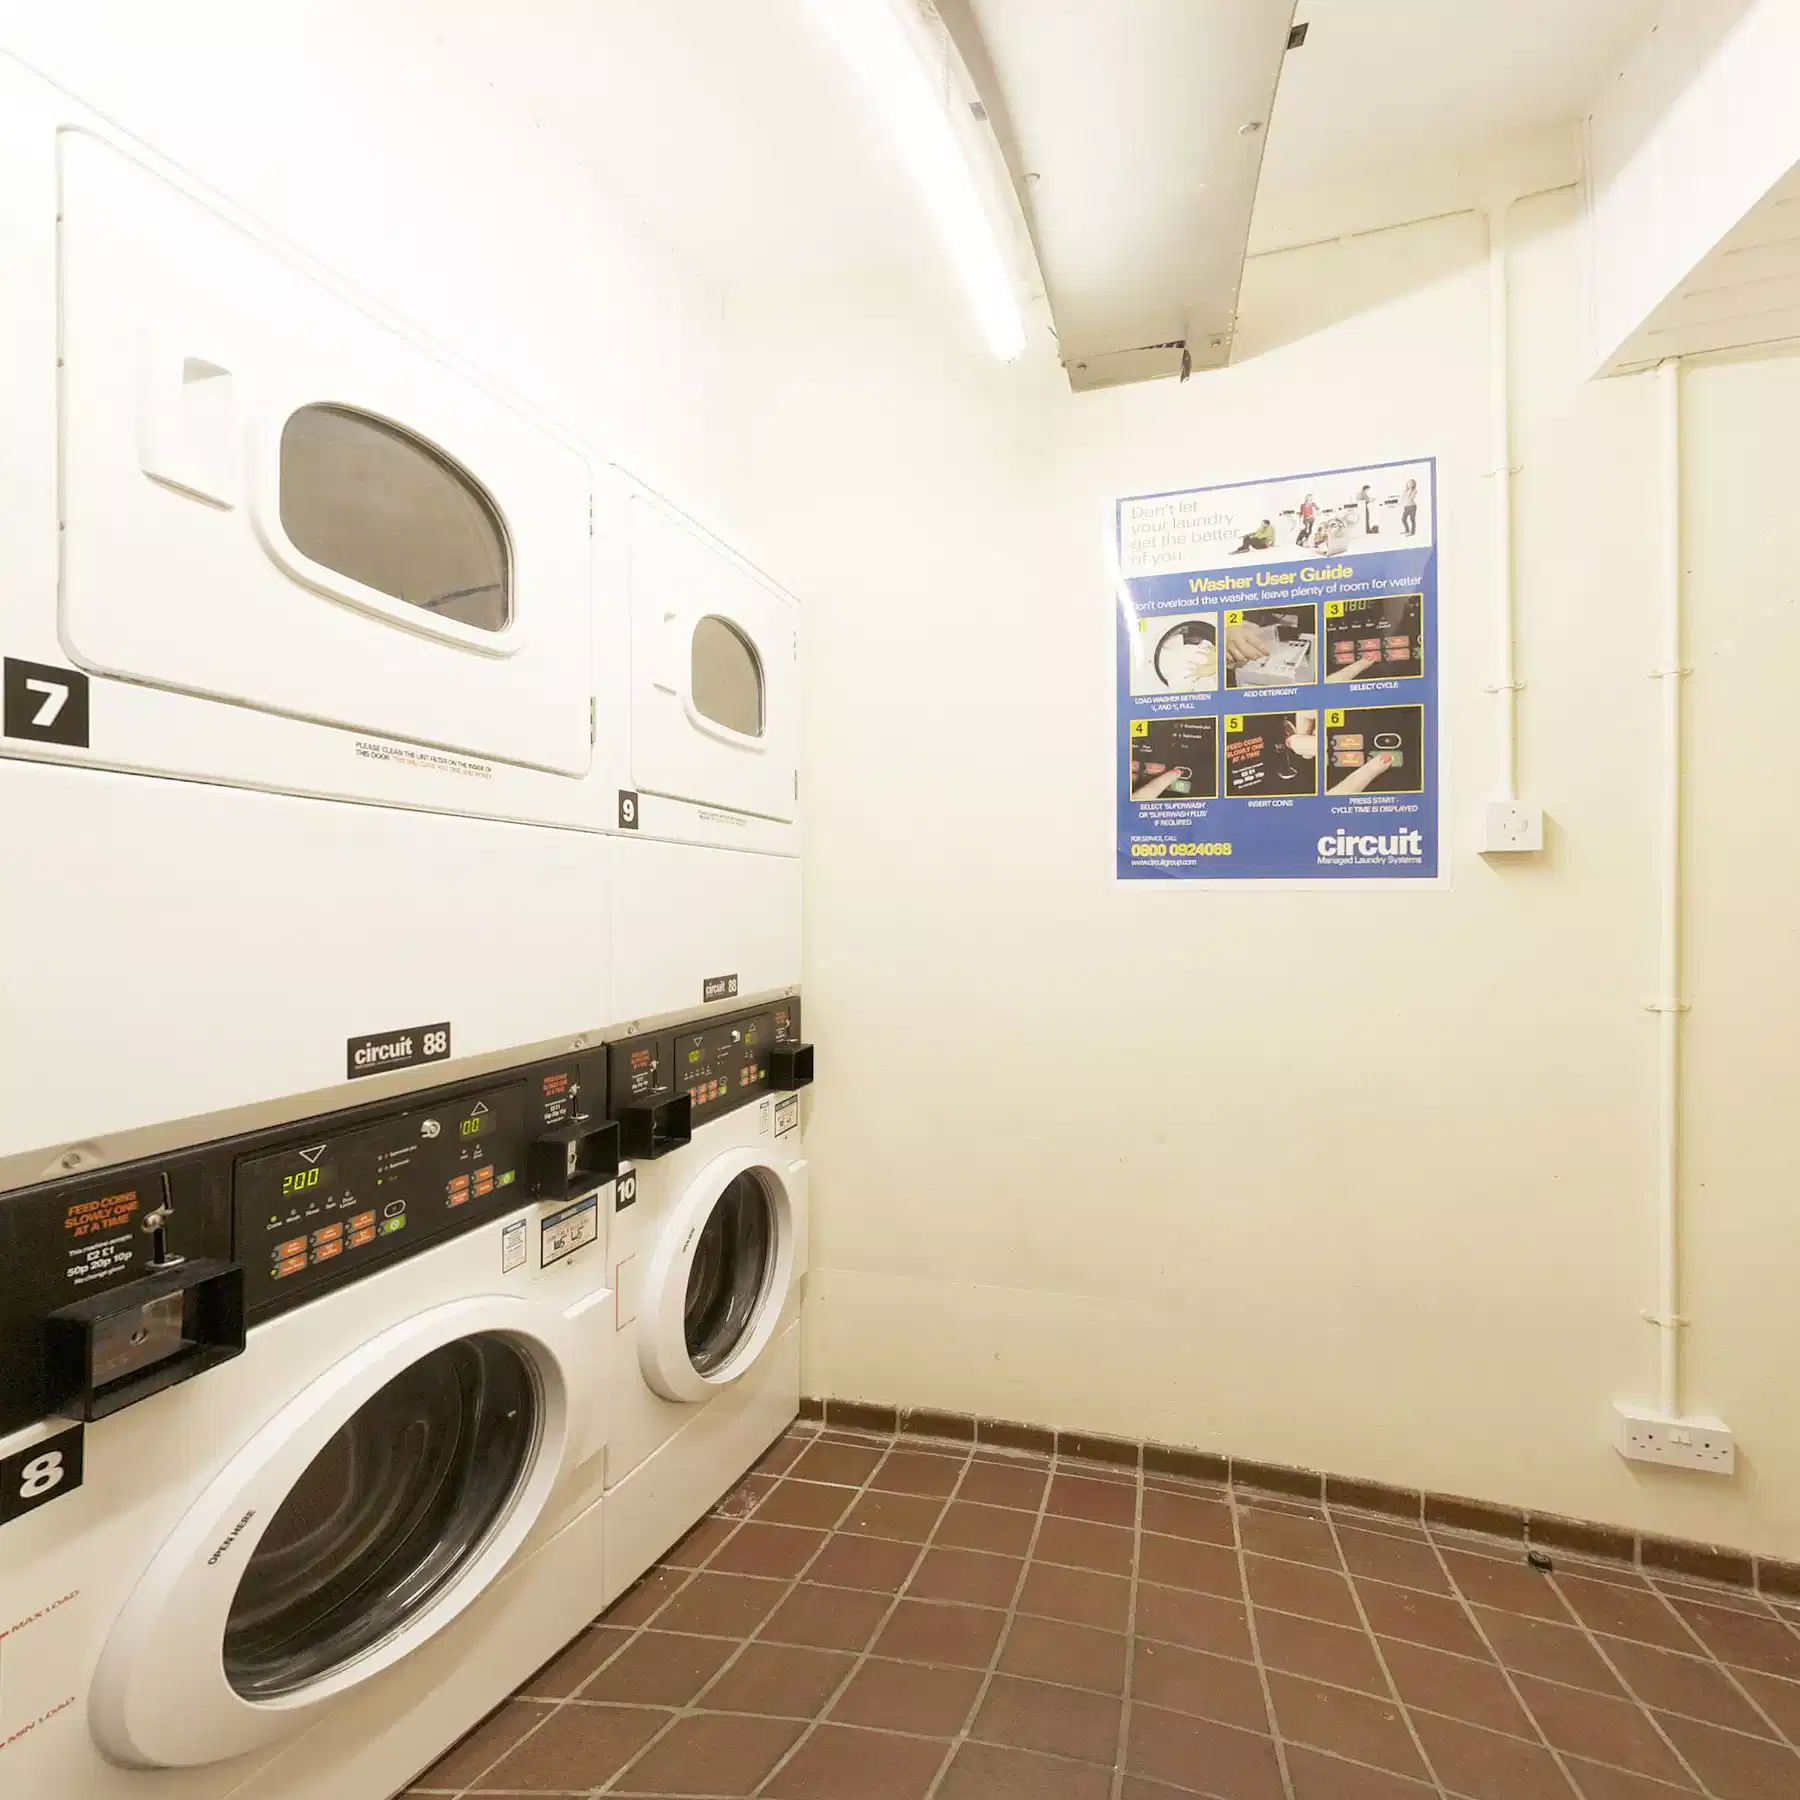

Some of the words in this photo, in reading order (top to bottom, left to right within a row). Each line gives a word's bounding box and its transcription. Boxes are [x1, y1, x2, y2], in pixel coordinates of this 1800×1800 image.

[1131, 503, 1174, 520] Don't
[1179, 501, 1197, 513] let
[1131, 521, 1169, 536] your
[1173, 512, 1236, 529] laundry
[1131, 534, 1156, 552] get
[1162, 532, 1186, 546] the
[1191, 529, 1240, 542] better
[1131, 553, 1148, 566] of
[1152, 552, 1187, 567] you.
[1189, 576, 1253, 593] Washer
[1256, 570, 1297, 588] User
[1300, 563, 1353, 583] Guide
[1158, 598, 1199, 610] overload
[1201, 596, 1218, 606] the
[1220, 593, 1258, 603] washer,
[1261, 589, 1289, 599] leave
[1291, 585, 1323, 599] plenty
[1326, 583, 1336, 594] of
[1340, 581, 1369, 592] room
[1372, 578, 1387, 589] for
[1388, 576, 1422, 588] water
[1229, 612, 1238, 624] 2
[1329, 604, 1339, 615] 3
[1258, 687, 1298, 697] DETERGENT
[1350, 683, 1376, 691] SELECT
[26, 678, 70, 728] 7
[1136, 723, 1143, 734] 4
[1229, 717, 1237, 729] 5
[1331, 712, 1339, 724] 6
[355, 741, 381, 752] PLEASE
[622, 798, 635, 822] 9
[1247, 800, 1271, 808] INSERT
[1271, 799, 1294, 808] COINS
[1131, 844, 1167, 857] 0800
[1168, 842, 1232, 857] 0924068
[1317, 827, 1423, 857] circuit
[1317, 856, 1353, 866] Managed
[1354, 855, 1386, 866] Laundry
[1387, 855, 1422, 866] Systems
[705, 981, 726, 996] circuit
[728, 979, 737, 993] 88
[354, 1036, 413, 1065] circuit
[423, 1030, 447, 1056] 88
[283, 1167, 320, 1195] 200
[617, 1177, 636, 1203] 10
[64, 1208, 113, 1228] SLOWLY
[113, 1201, 139, 1214] ONE
[68, 1200, 100, 1217] FEED
[100, 1191, 137, 1208] COINS
[74, 1224, 89, 1237] AT
[91, 1221, 101, 1231] A
[102, 1213, 129, 1228] TIME
[66, 1264, 89, 1278] 50p
[89, 1257, 113, 1270] 20p
[112, 1250, 133, 1264] 10p
[86, 1250, 100, 1261] £2
[101, 1246, 115, 1257] £1
[19, 1450, 65, 1499] 8
[207, 1536, 235, 1565] OPEN
[230, 1509, 256, 1536] HERE
[11, 1610, 42, 1633] MAX
[45, 1589, 80, 1613] LOAD
[38, 1696, 76, 1724] LOAD
